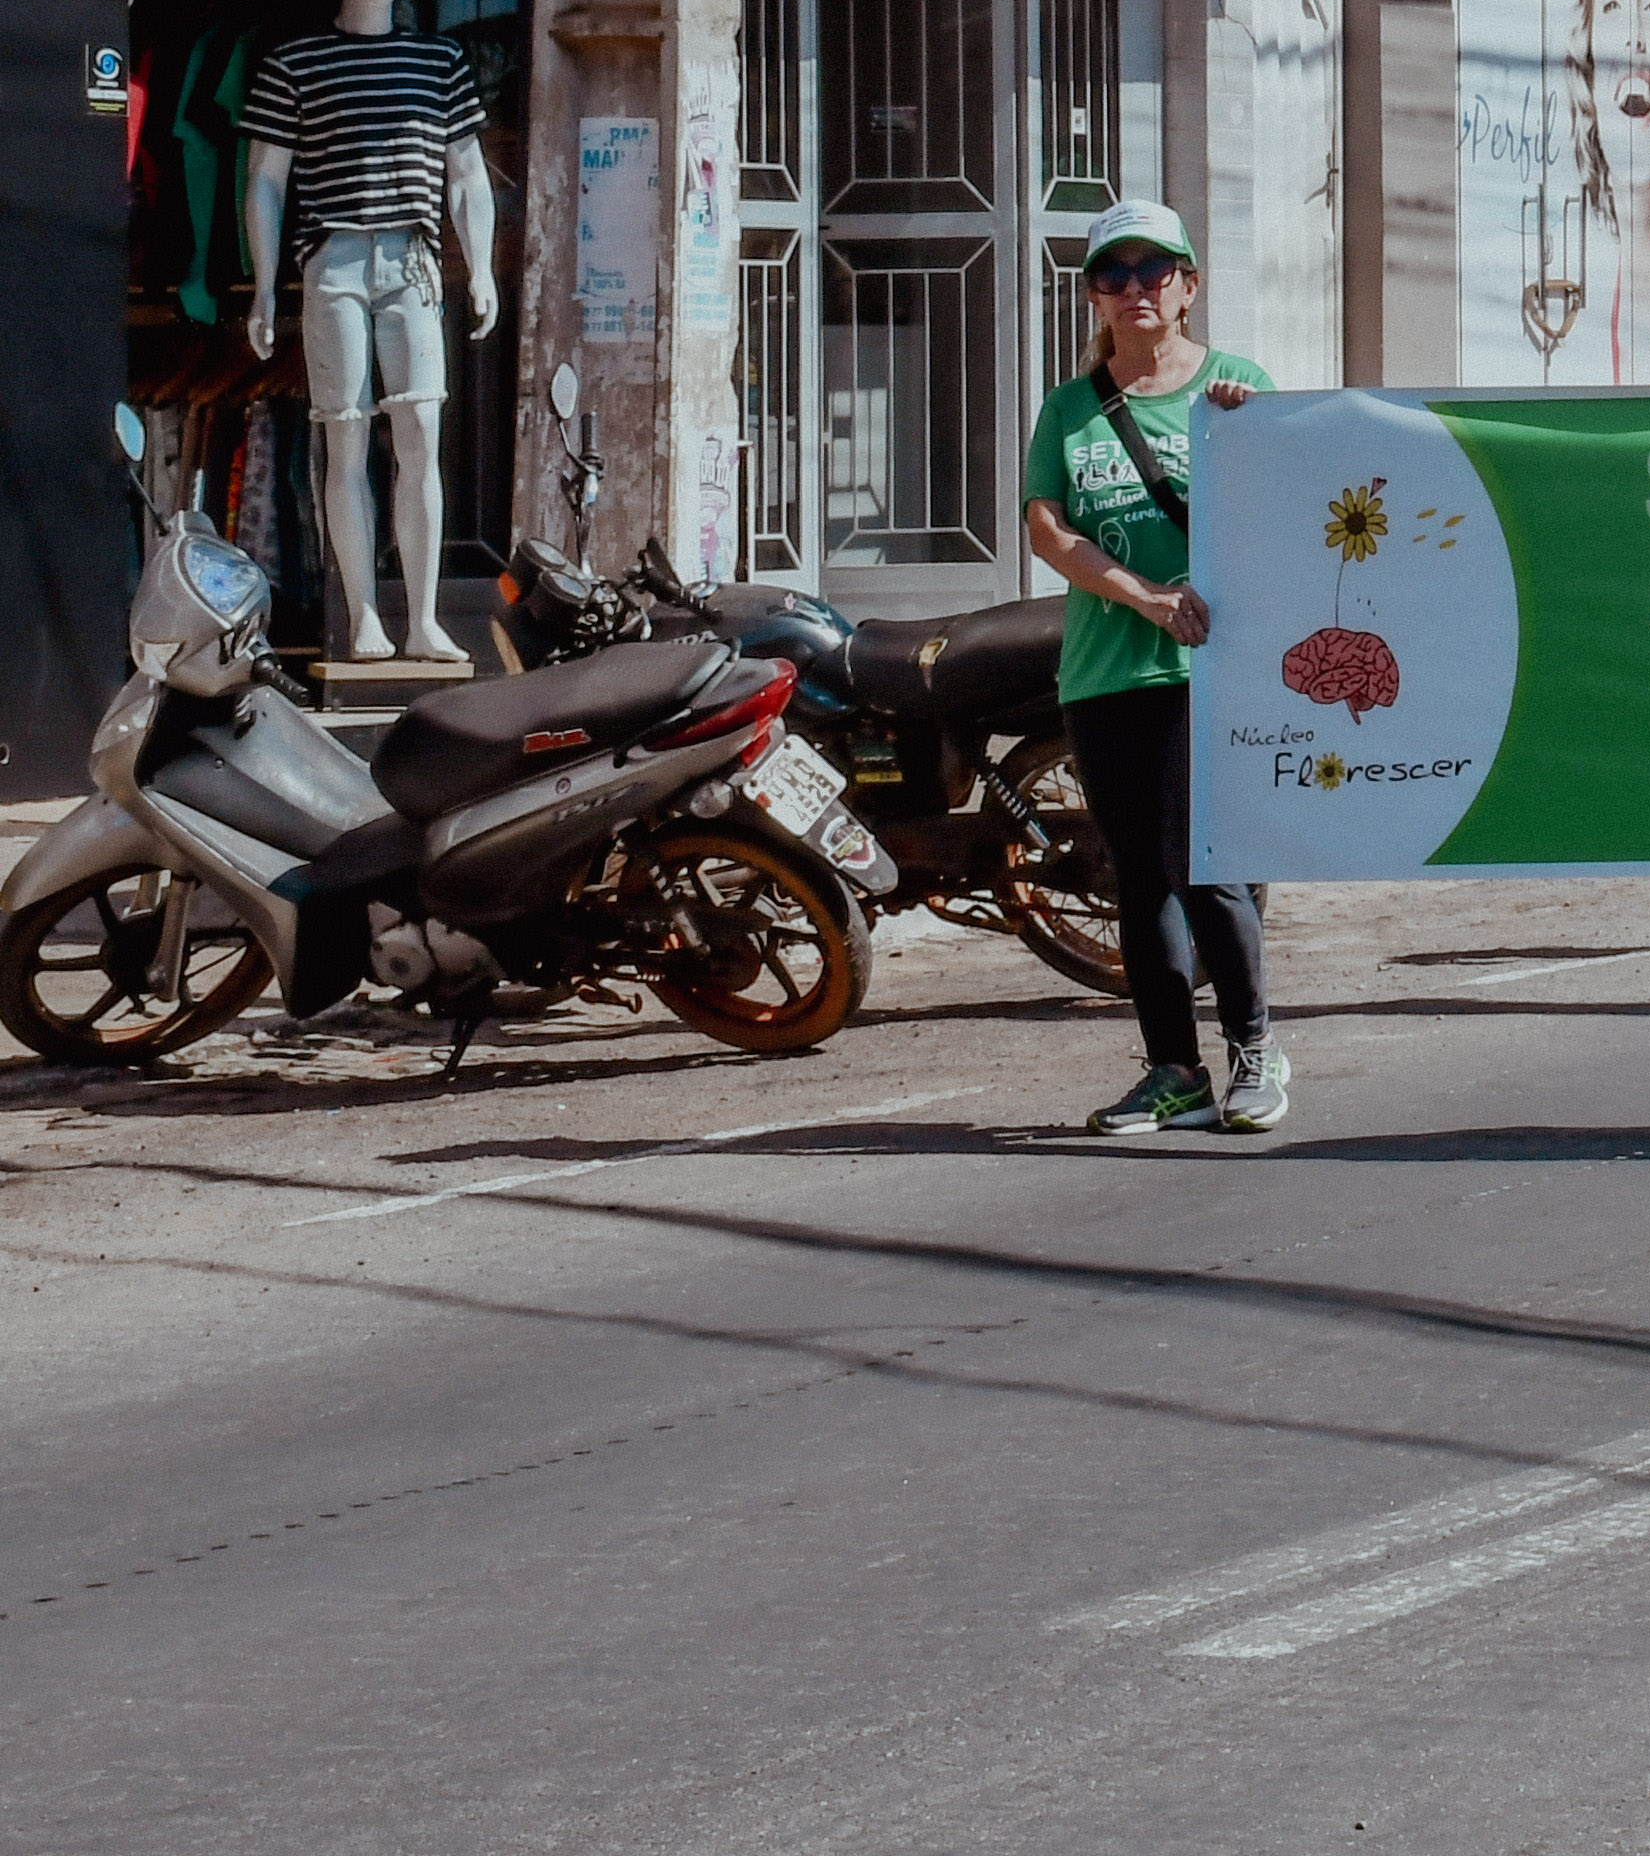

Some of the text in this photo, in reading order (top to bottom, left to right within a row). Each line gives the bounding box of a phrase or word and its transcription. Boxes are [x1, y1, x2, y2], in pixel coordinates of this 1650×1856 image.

[1472, 85, 1560, 184] Perfil
[1230, 724, 1316, 747] Núcleo
[1274, 750, 1473, 791] Florescer
